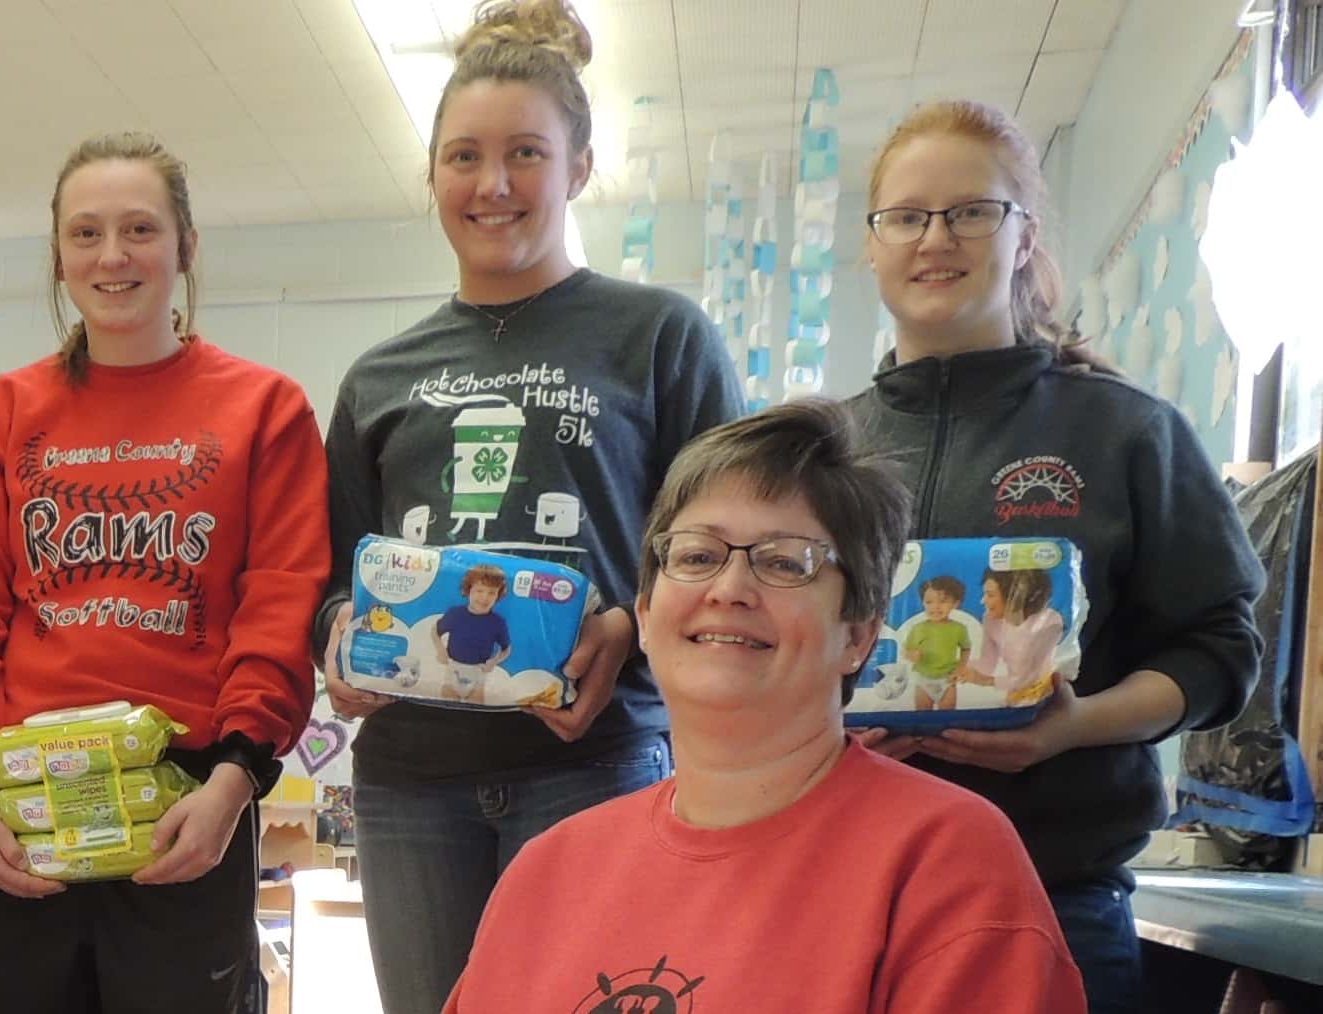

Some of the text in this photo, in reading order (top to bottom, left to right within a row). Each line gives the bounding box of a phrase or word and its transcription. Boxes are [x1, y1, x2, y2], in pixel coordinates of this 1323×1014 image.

[409, 363, 565, 400] Hot Chocolate
[522, 385, 600, 416] Hustle
[555, 414, 594, 448] 5k
[44, 438, 196, 470] Greene County
[991, 460, 1023, 484] GREENE
[1024, 456, 1066, 466] COUNTY
[22, 497, 216, 577] Rams
[362, 552, 433, 572] DG kids
[39, 597, 189, 634] Softball
[39, 735, 112, 752] value pack
